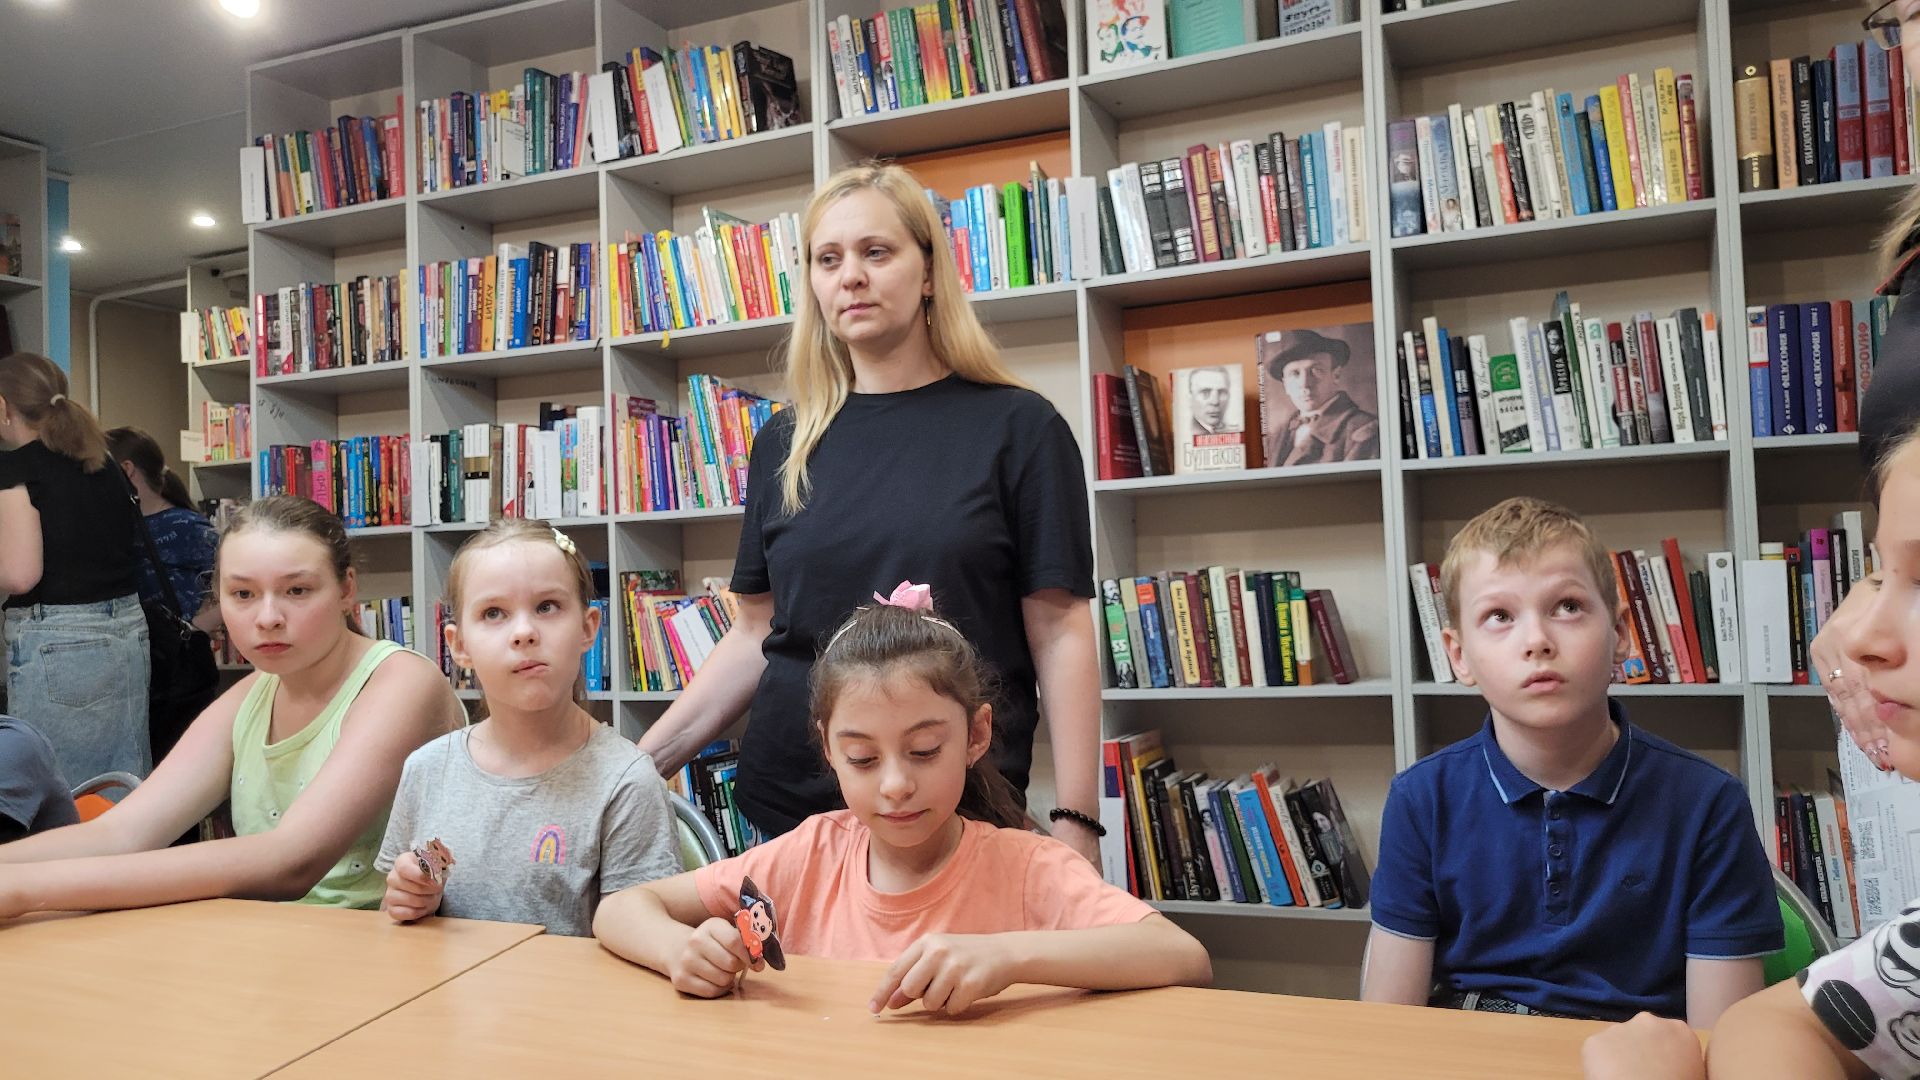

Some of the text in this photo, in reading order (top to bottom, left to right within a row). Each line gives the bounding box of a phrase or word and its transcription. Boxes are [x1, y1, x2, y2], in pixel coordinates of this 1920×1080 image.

[1780, 111, 1792, 176] СОВРЕМЕННЫЙ
[1800, 99, 1814, 165] НУМЕРОЛОГИЯ
[484, 284, 493, 320] АУДИТ
[1779, 333, 1791, 389] ФИЛОСОФИЯ
[1811, 332, 1823, 387] ФИЛОСОФИЯ
